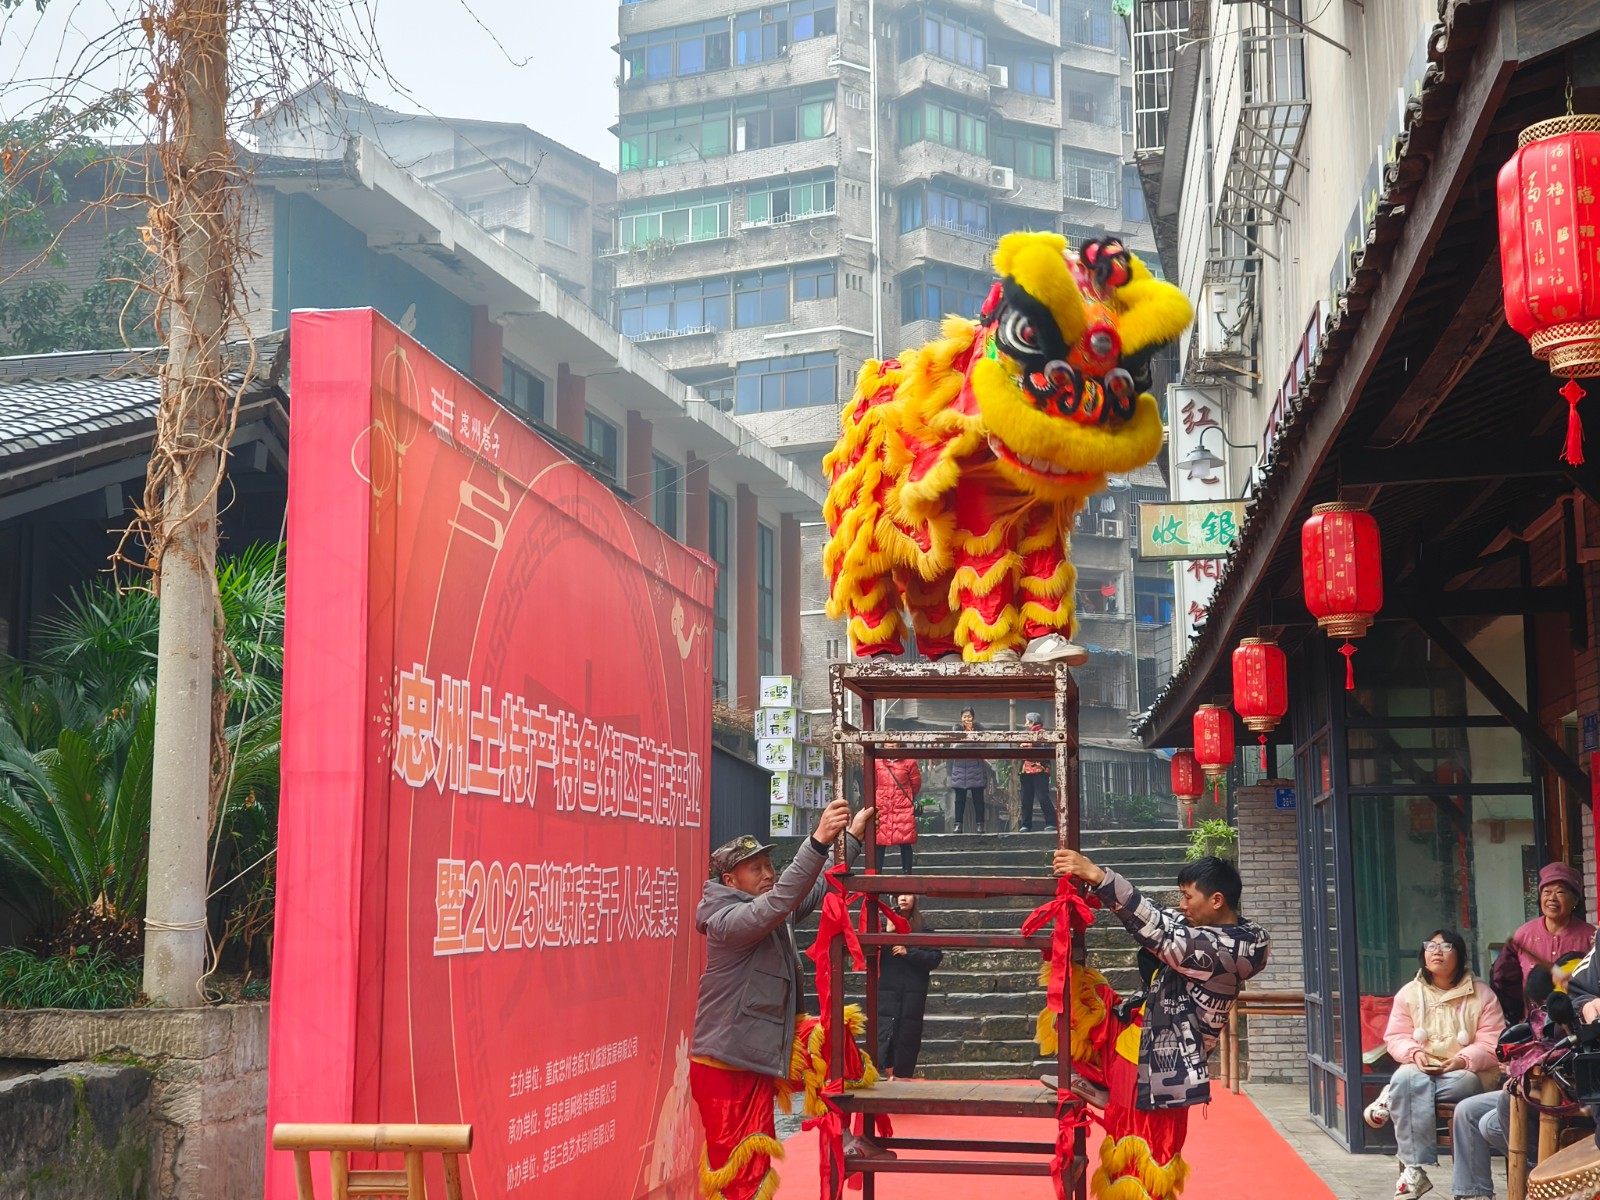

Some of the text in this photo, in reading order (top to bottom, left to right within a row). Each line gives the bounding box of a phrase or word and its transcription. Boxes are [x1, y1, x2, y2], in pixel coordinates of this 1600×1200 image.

[459, 409, 500, 459] 忠州巷子
[393, 662, 702, 828] 忠州土特产特色街区首店开业
[433, 858, 679, 956] 暨2025迎新春千人长桌宴
